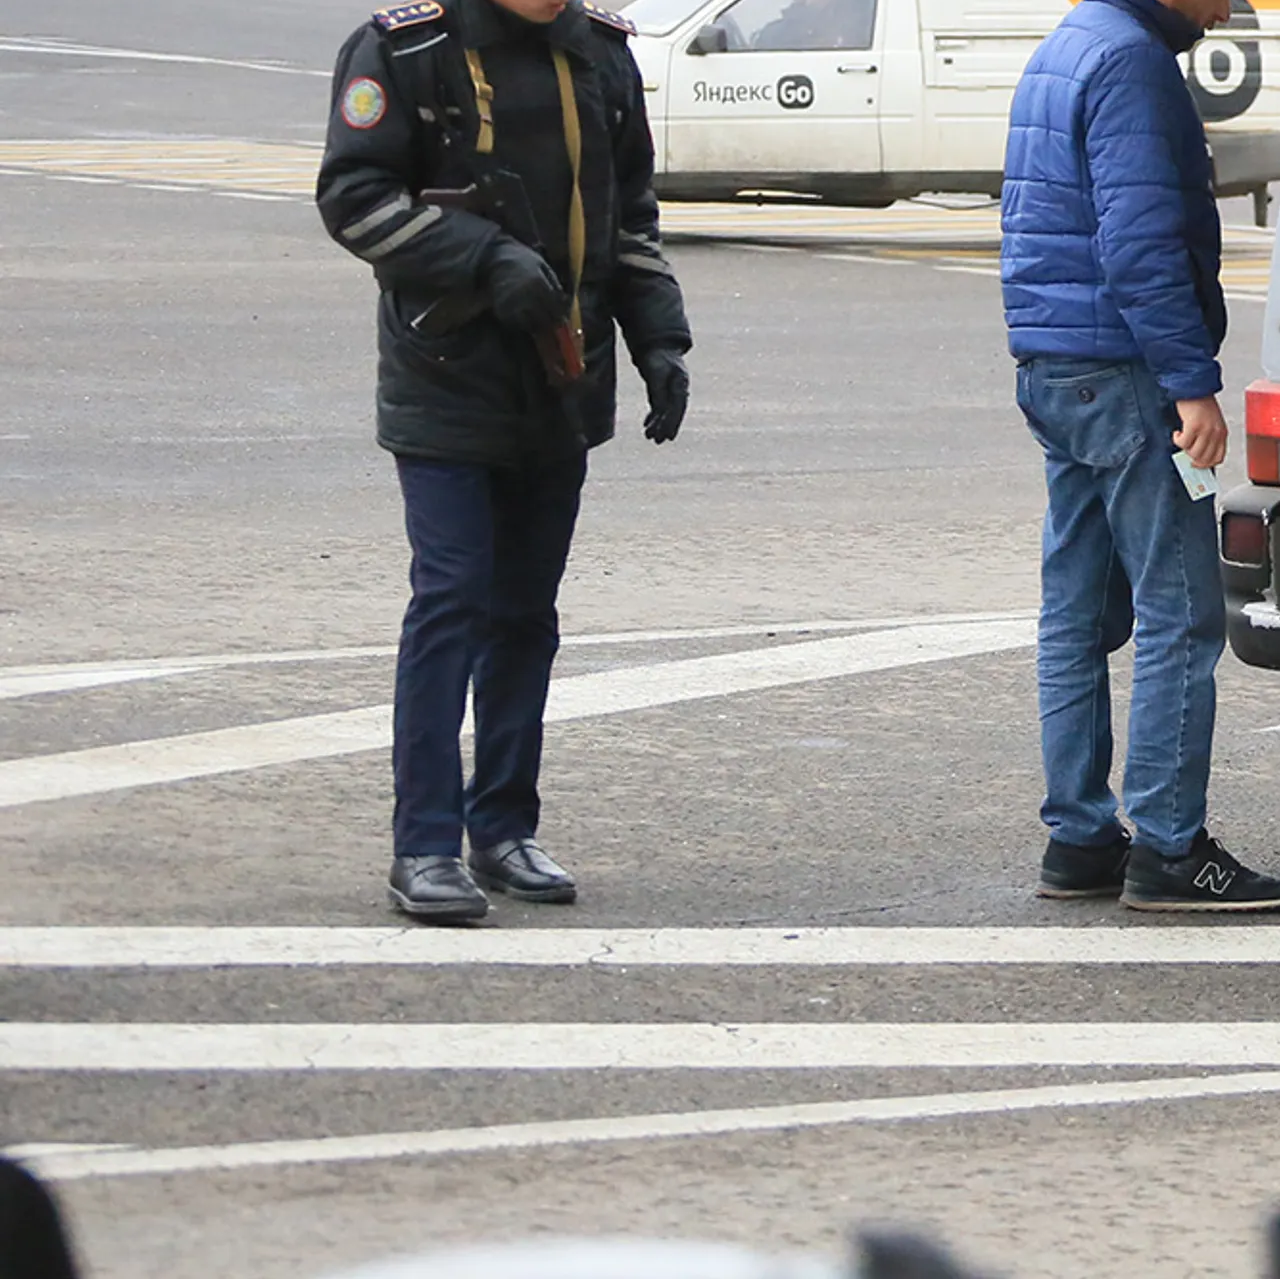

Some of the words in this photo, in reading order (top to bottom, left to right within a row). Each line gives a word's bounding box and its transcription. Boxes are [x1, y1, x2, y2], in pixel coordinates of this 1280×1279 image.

[693, 80, 773, 104] Яндекс
[780, 80, 812, 104] Go
[1194, 861, 1236, 895] N
